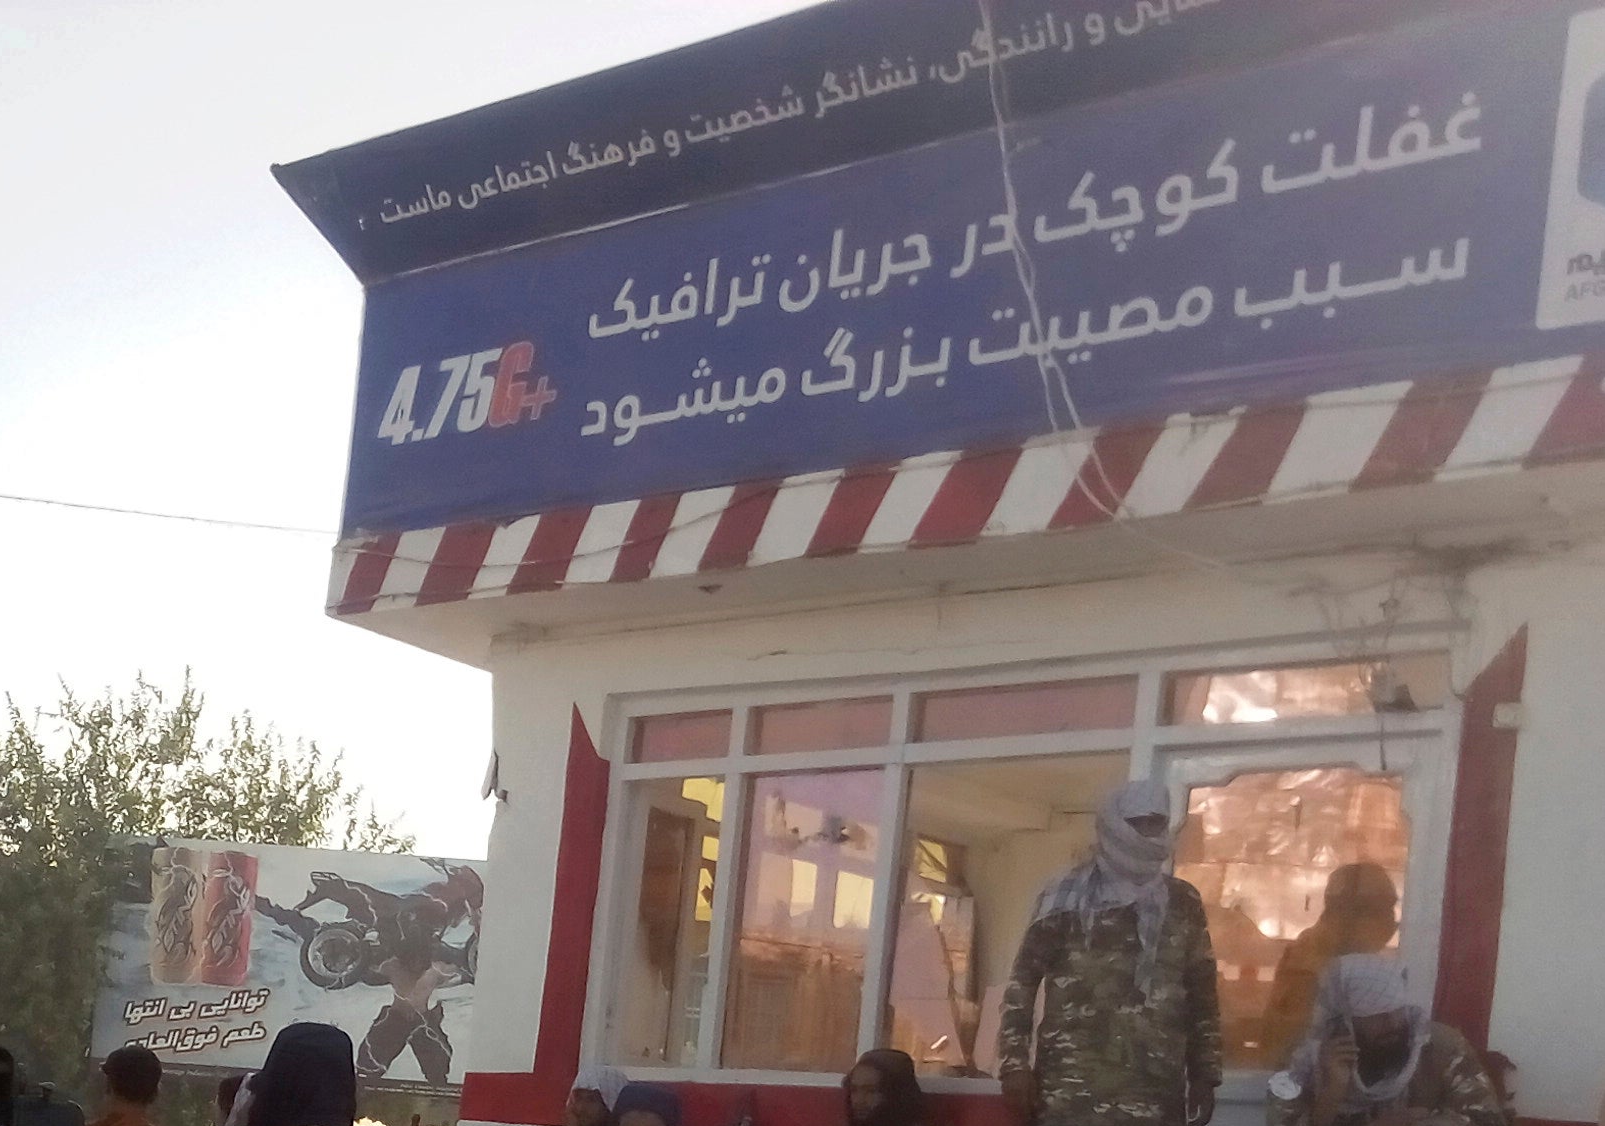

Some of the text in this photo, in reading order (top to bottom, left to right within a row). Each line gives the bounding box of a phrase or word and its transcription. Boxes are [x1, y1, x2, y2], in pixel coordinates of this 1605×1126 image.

[1084, 11, 1106, 46] و
[684, 84, 806, 143] شخصیت
[814, 54, 918, 119] نشانگر
[561, 127, 657, 176] فرهنگ
[663, 128, 682, 158] و
[379, 183, 453, 224] ماست
[457, 150, 559, 210] اجتماعی
[587, 91, 1482, 342] غفلت کوچک در جریان ترافیک
[1232, 236, 1471, 330] سبب
[968, 285, 1215, 367] مصیبت
[376, 340, 559, 446] 4.75G+
[799, 326, 952, 403] بزرگ
[124, 997, 168, 1026] انتها
[198, 987, 270, 1019] توانایی
[221, 1021, 267, 1049] طعم
